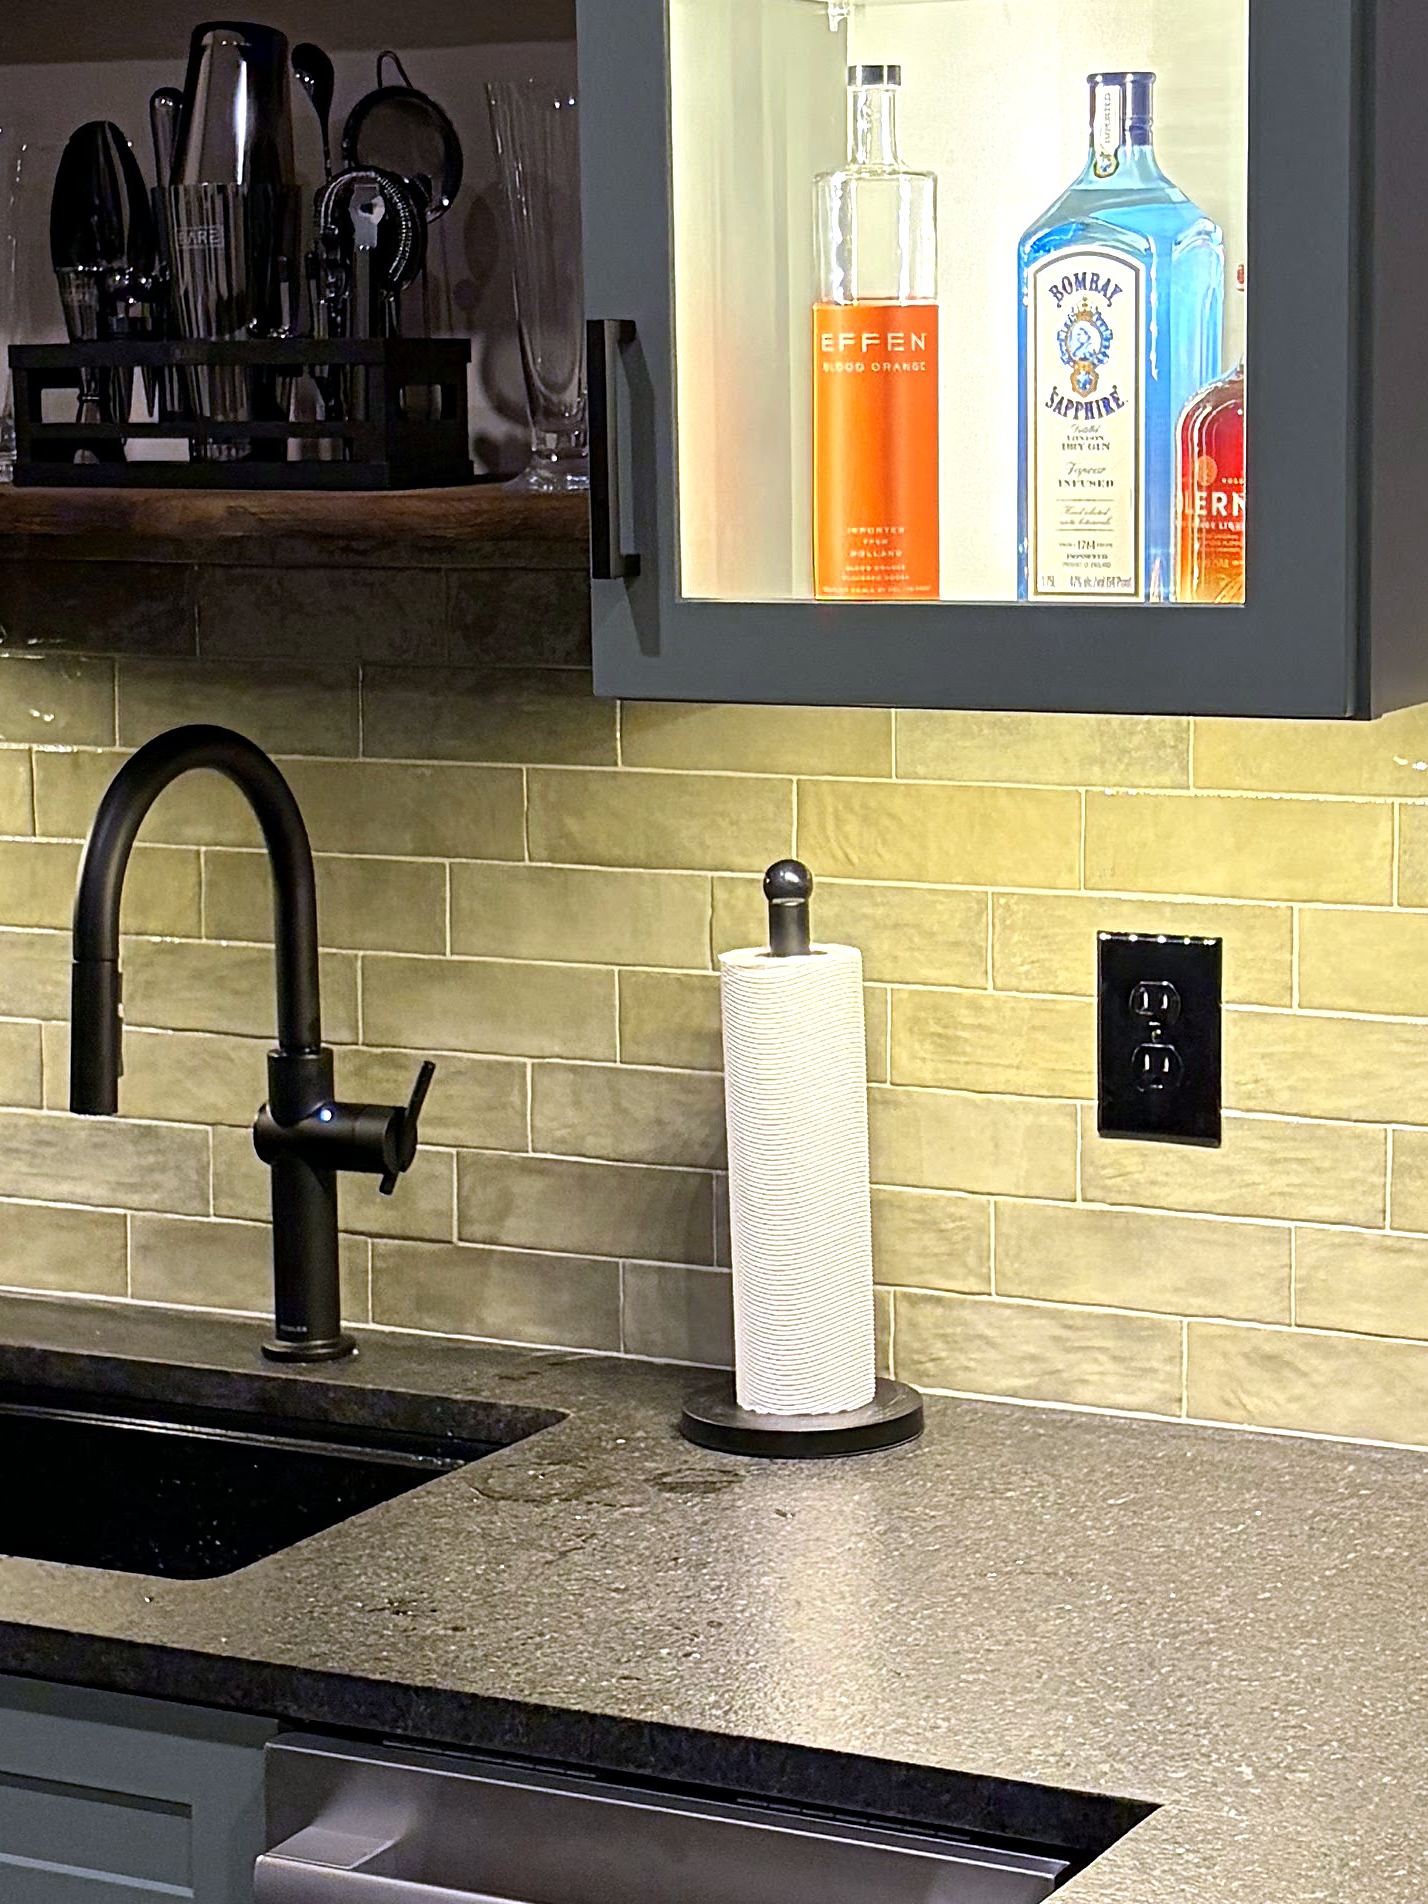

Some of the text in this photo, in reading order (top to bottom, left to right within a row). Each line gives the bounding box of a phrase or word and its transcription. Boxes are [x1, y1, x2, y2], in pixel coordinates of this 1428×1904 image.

[1048, 271, 1123, 308] BOMBAY
[821, 332, 927, 353] EFFEN
[822, 360, 926, 373] BLOOD ORANGE
[1044, 384, 1126, 421] SAPPHIRE
